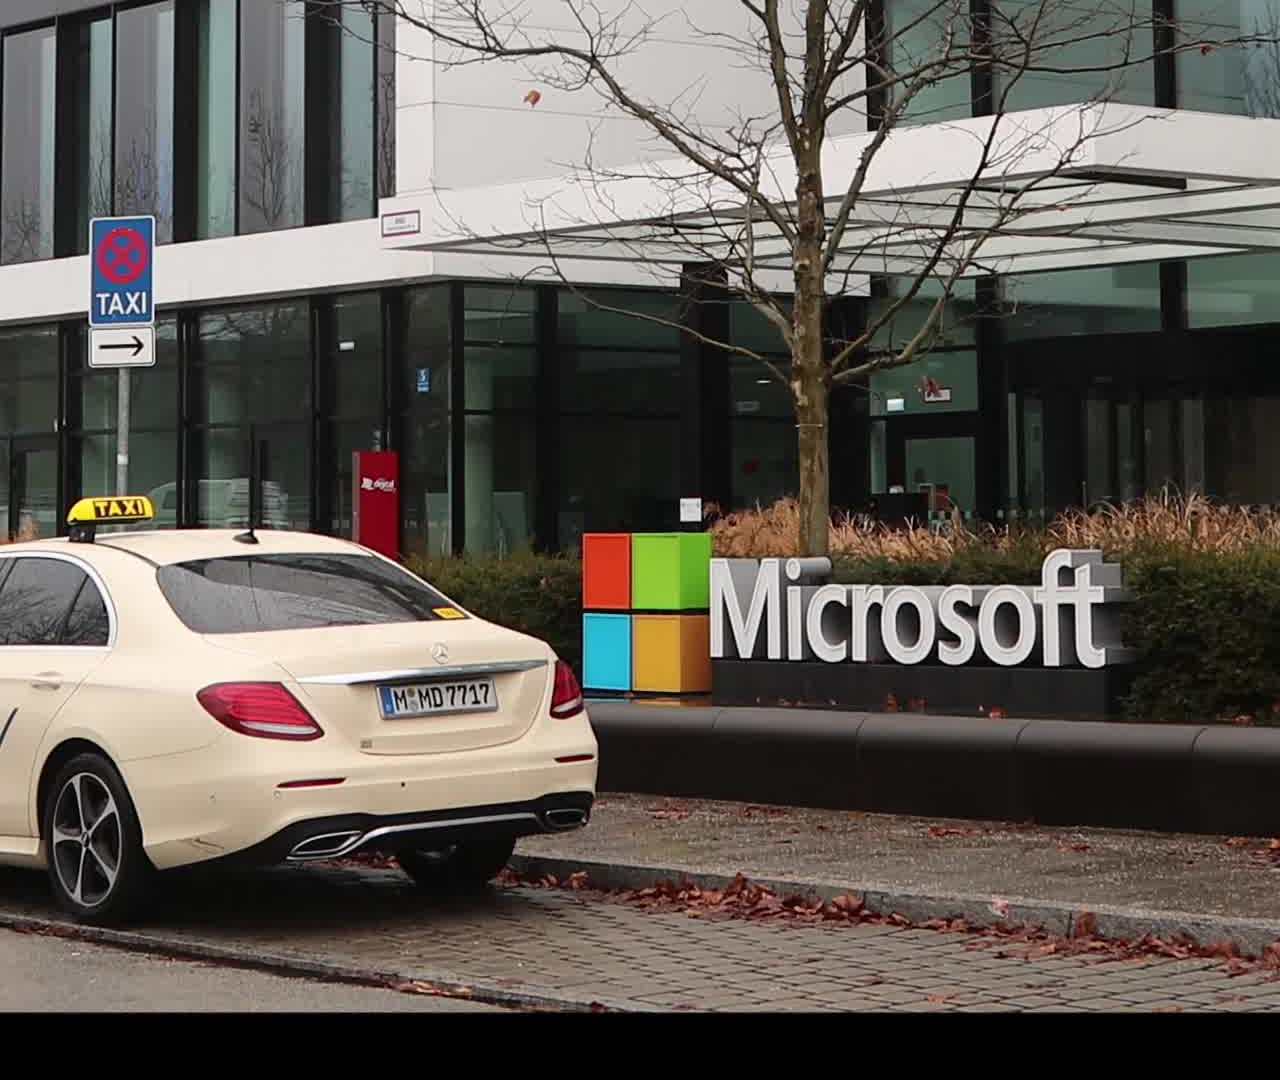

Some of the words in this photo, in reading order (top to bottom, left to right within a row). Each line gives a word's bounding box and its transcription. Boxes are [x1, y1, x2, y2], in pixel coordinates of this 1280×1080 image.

[96, 291, 147, 316] TAXI
[95, 500, 145, 517] TAXI
[708, 548, 1107, 670] Microsoft
